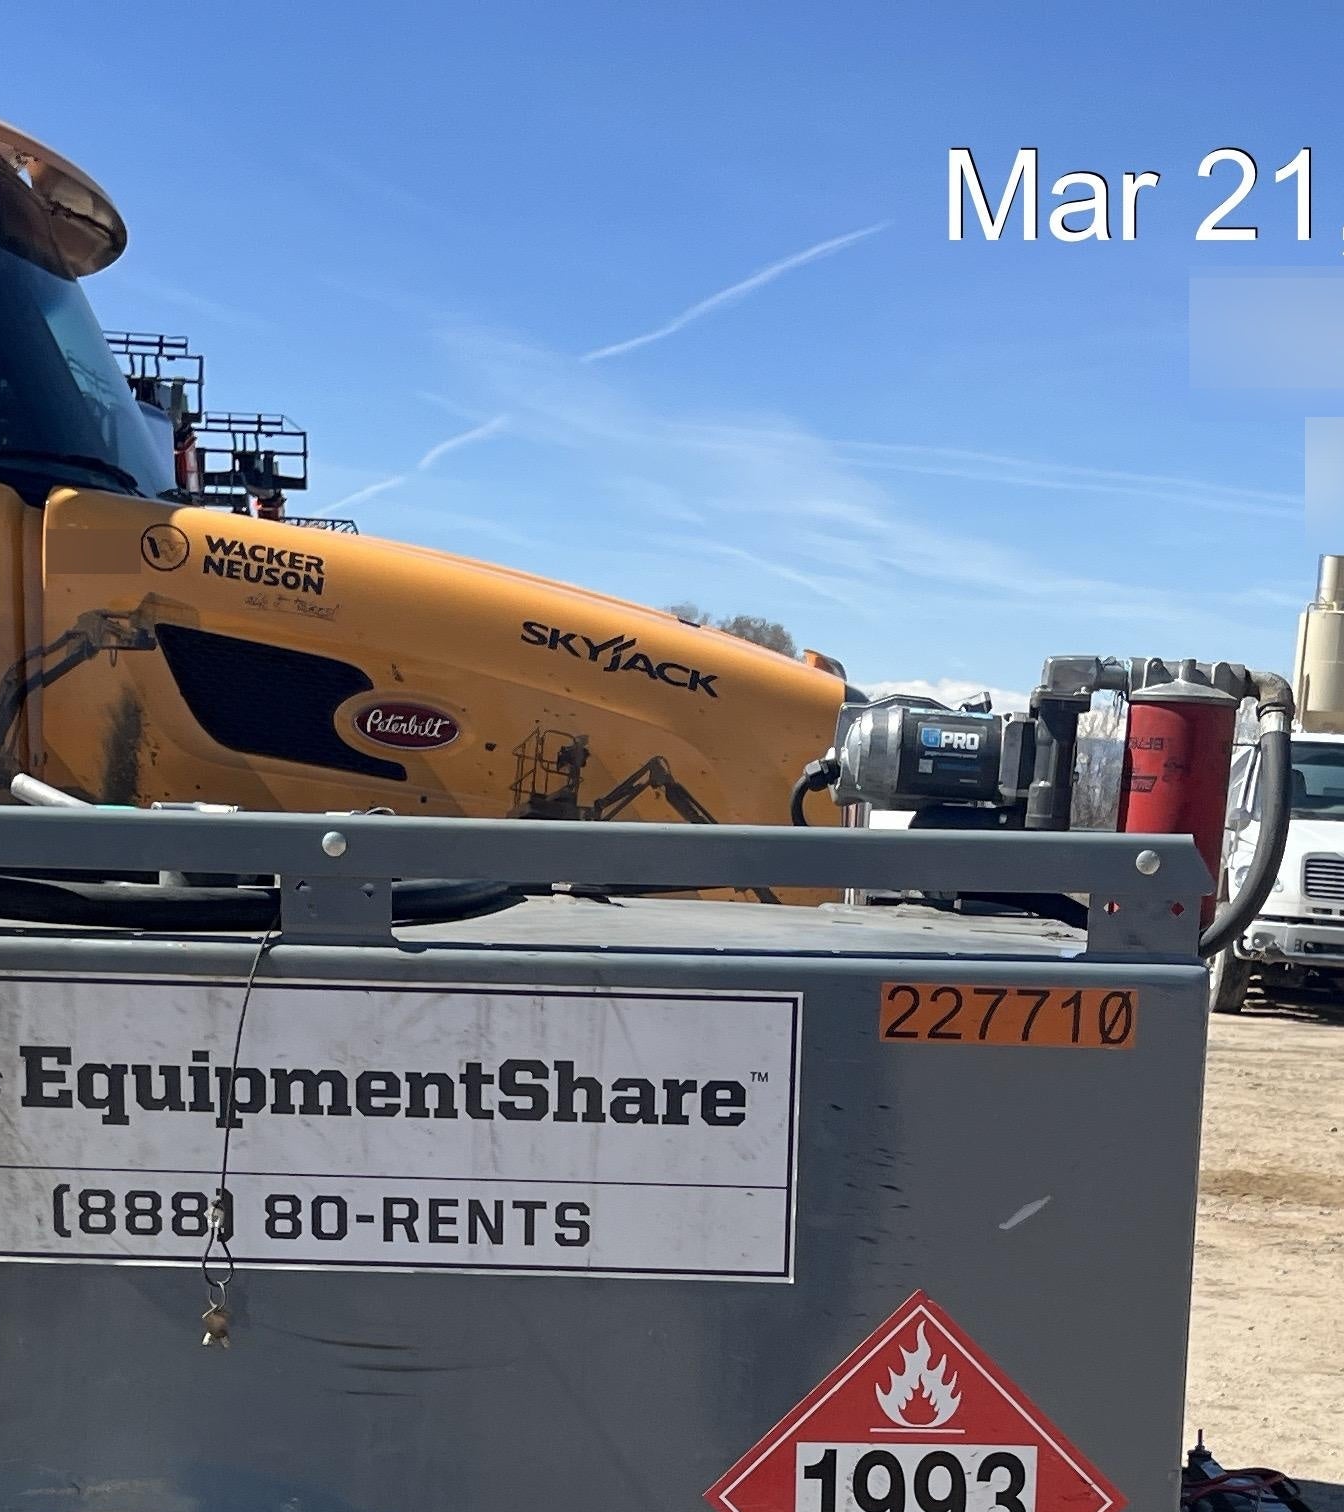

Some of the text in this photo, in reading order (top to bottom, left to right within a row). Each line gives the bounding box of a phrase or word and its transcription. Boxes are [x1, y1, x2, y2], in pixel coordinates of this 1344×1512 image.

[202, 555, 325, 596] NEUSON
[205, 534, 325, 577] WACKER
[520, 620, 720, 699] SKYJACK
[366, 708, 450, 738] Peterbilt
[883, 984, 1135, 1046] 227710
[19, 1045, 748, 1128] EquipmentShare
[53, 1183, 592, 1247] (888) 80-RENTS
